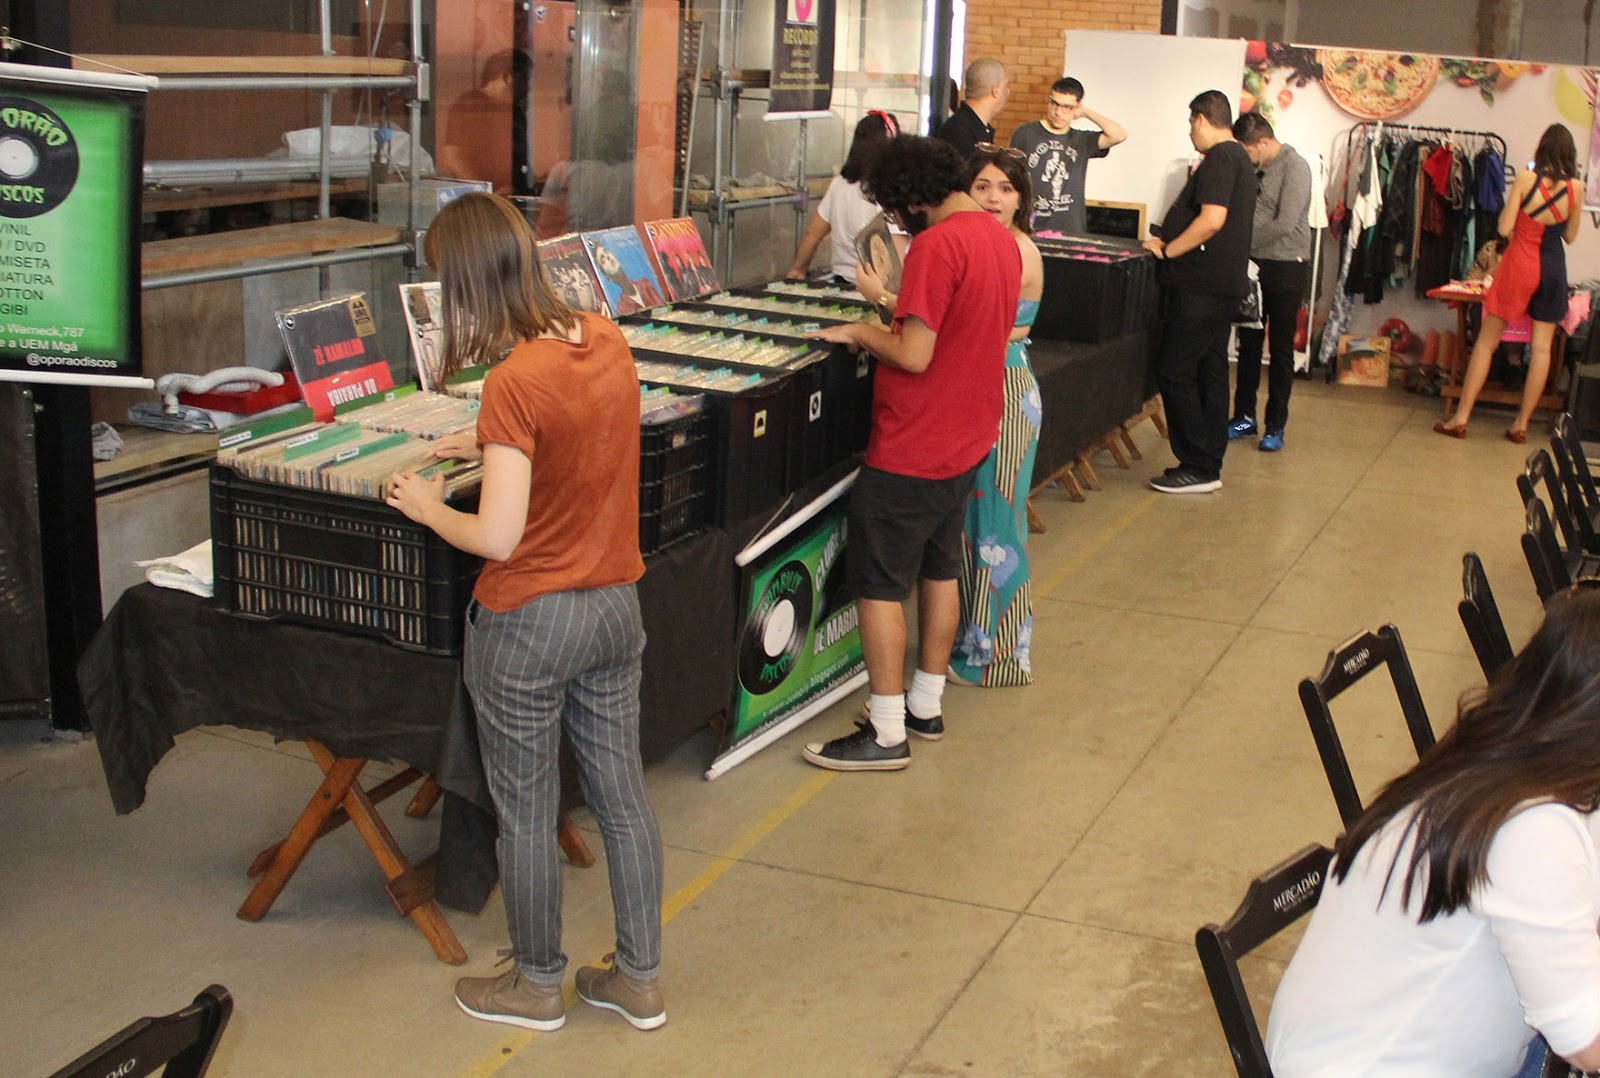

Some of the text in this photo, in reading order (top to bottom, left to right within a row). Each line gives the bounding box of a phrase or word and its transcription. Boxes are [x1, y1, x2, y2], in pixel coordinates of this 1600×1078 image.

[0, 107, 68, 146] ORÃO
[0, 185, 45, 204] SCOS
[15, 240, 46, 253] DVD
[0, 272, 54, 286] IATURA
[0, 303, 28, 315] GIBI
[8, 341, 16, 349] a
[19, 339, 49, 350] UEM
[26, 352, 118, 369] @oporaodiscos
[826, 605, 859, 646] MARIN
[1273, 871, 1320, 912] MERCADÃO
